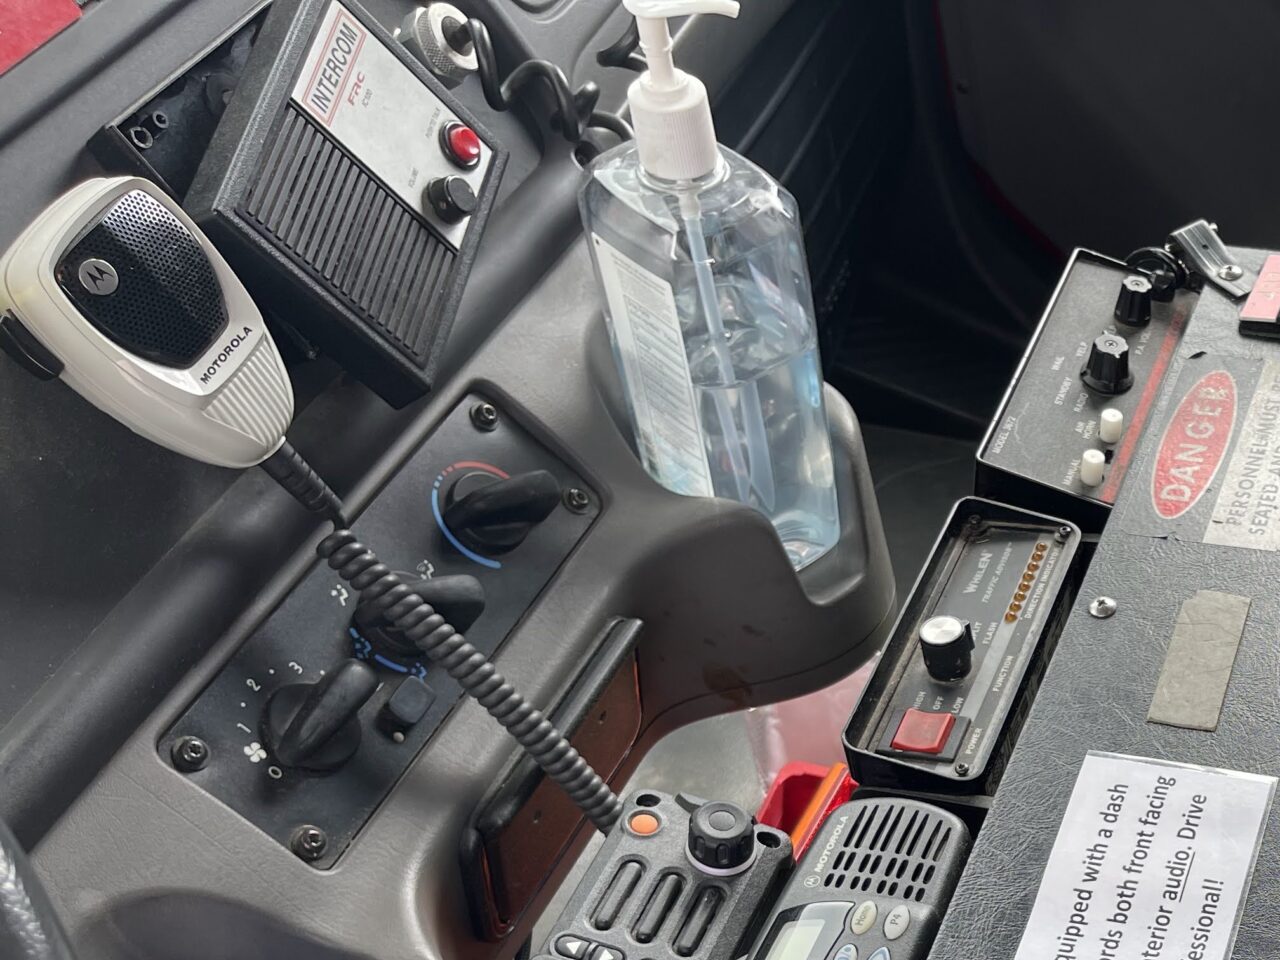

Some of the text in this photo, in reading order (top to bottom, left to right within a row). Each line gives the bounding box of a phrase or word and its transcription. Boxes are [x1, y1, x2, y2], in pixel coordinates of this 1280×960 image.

[310, 21, 358, 115] INTERCOM
[347, 71, 366, 107] FRC
[200, 326, 253, 384] MOTOROLA
[1054, 377, 1073, 406] STANDBY
[1073, 392, 1089, 413] RADIO
[993, 429, 1010, 454] MODEL
[1160, 387, 1229, 502] DANGER
[1061, 459, 1081, 486] MANUAL
[1225, 438, 1268, 527] PERSONNEL
[1257, 397, 1280, 442] MUST
[1248, 483, 1280, 536] SEATED
[963, 551, 993, 594] WHELEN
[981, 575, 999, 603] TRAFFIC
[1024, 580, 1046, 619] DIRECTION
[972, 620, 982, 640] PLIT
[982, 621, 998, 645] FLASH
[246, 678, 261, 691] 2
[288, 661, 303, 674] 3
[992, 655, 1014, 692] FUNCTION
[913, 691, 927, 710] HIGH
[932, 695, 944, 711] OFF
[951, 696, 964, 714] LOW
[237, 723, 251, 733] 1
[965, 727, 983, 755] POWER
[1104, 783, 1129, 823] dash
[1139, 775, 1177, 826] facing
[1177, 794, 1208, 841] Drive
[813, 815, 849, 873] MOTOROLA
[1098, 827, 1114, 839] a
[1082, 842, 1108, 883] with
[1122, 831, 1155, 874] front
[1162, 846, 1194, 902] audio.
[889, 913, 902, 926] P4
[1106, 879, 1139, 924] both
